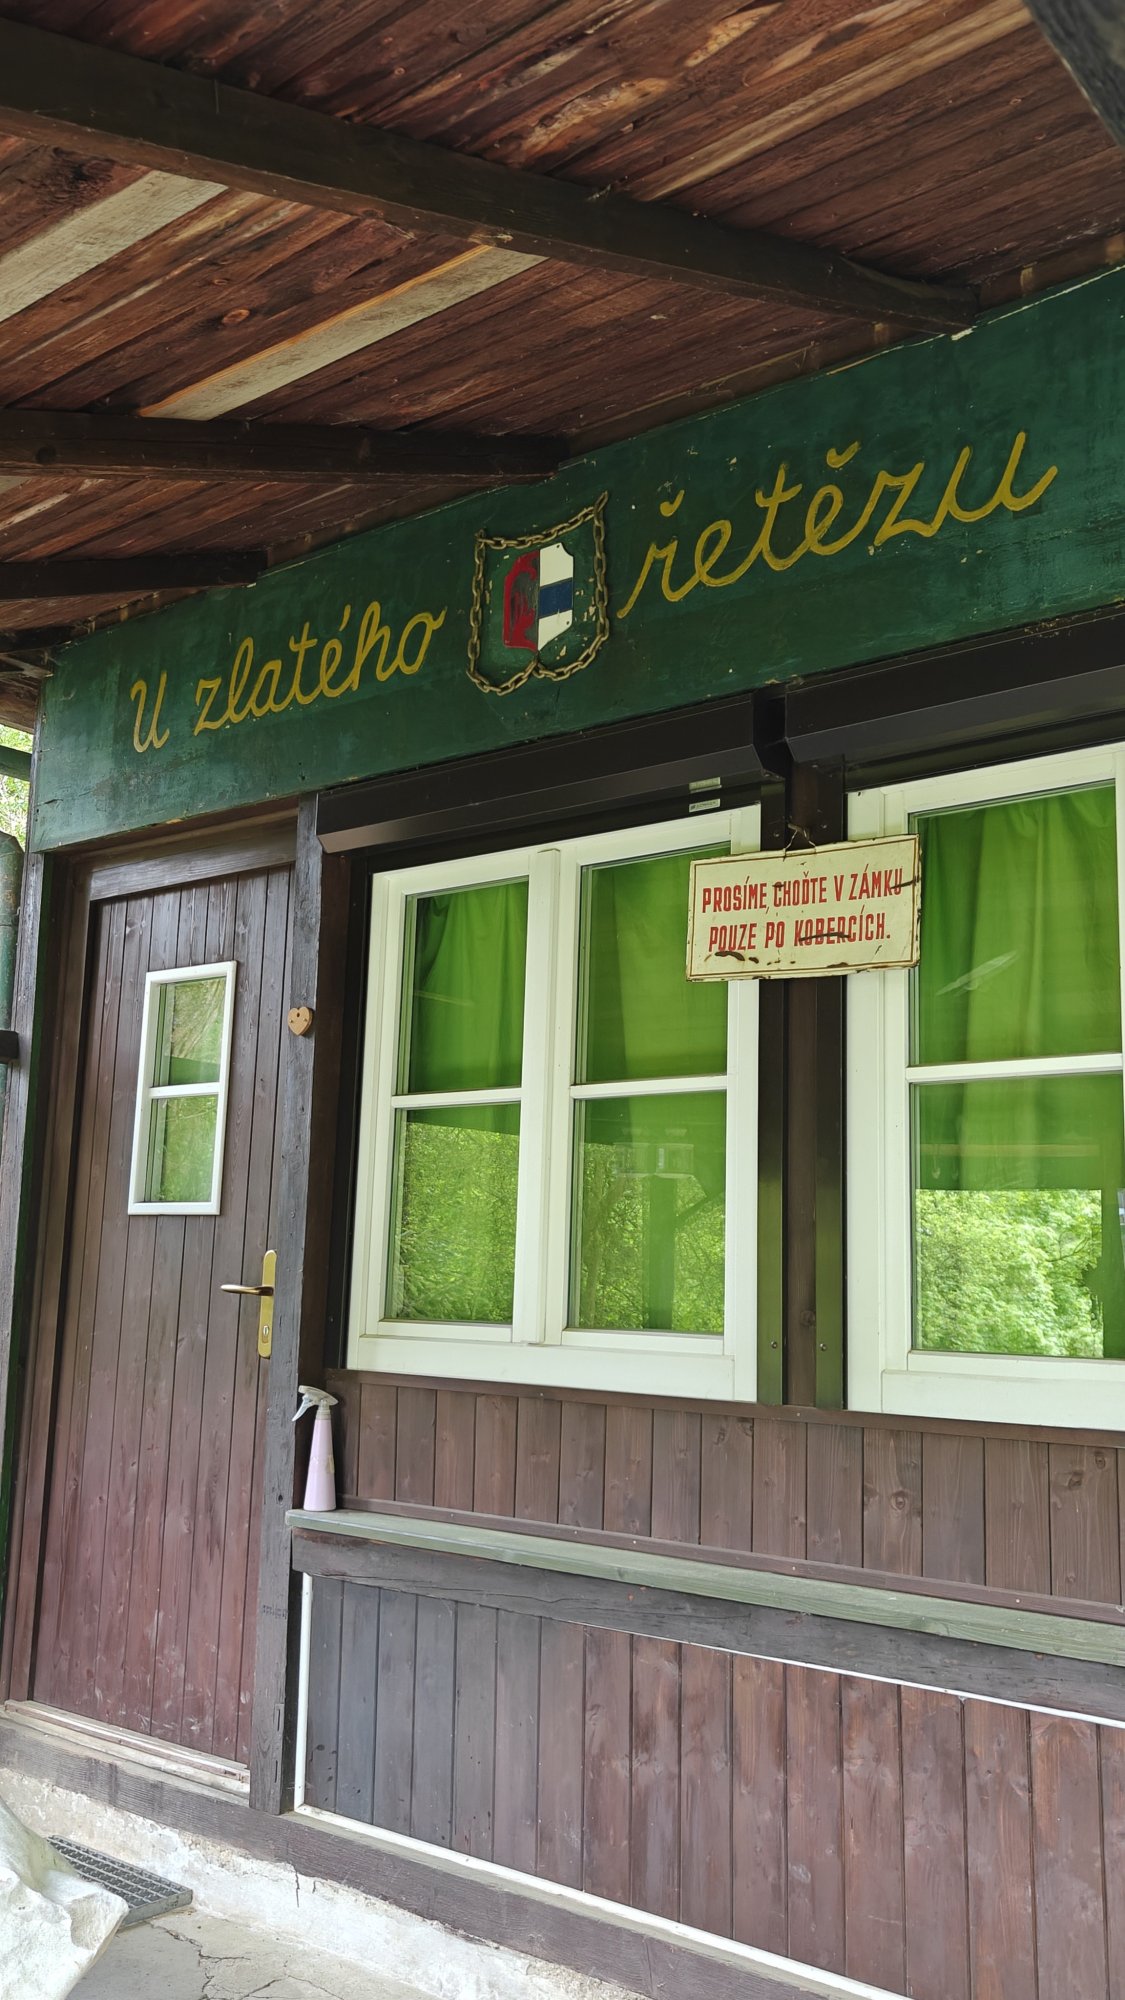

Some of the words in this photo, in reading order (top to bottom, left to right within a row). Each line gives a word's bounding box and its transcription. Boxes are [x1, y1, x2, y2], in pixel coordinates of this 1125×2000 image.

[130, 669, 170, 754] U
[194, 600, 446, 736] zlatého
[616, 430, 1059, 619] řetězu
[772, 871, 827, 908] CHOĎTE
[833, 874, 844, 902] V
[848, 863, 903, 901] ZÁMKU
[708, 922, 757, 953] POUZE
[764, 921, 786, 949] PO
[794, 904, 891, 947] KOBERCÍCH.
